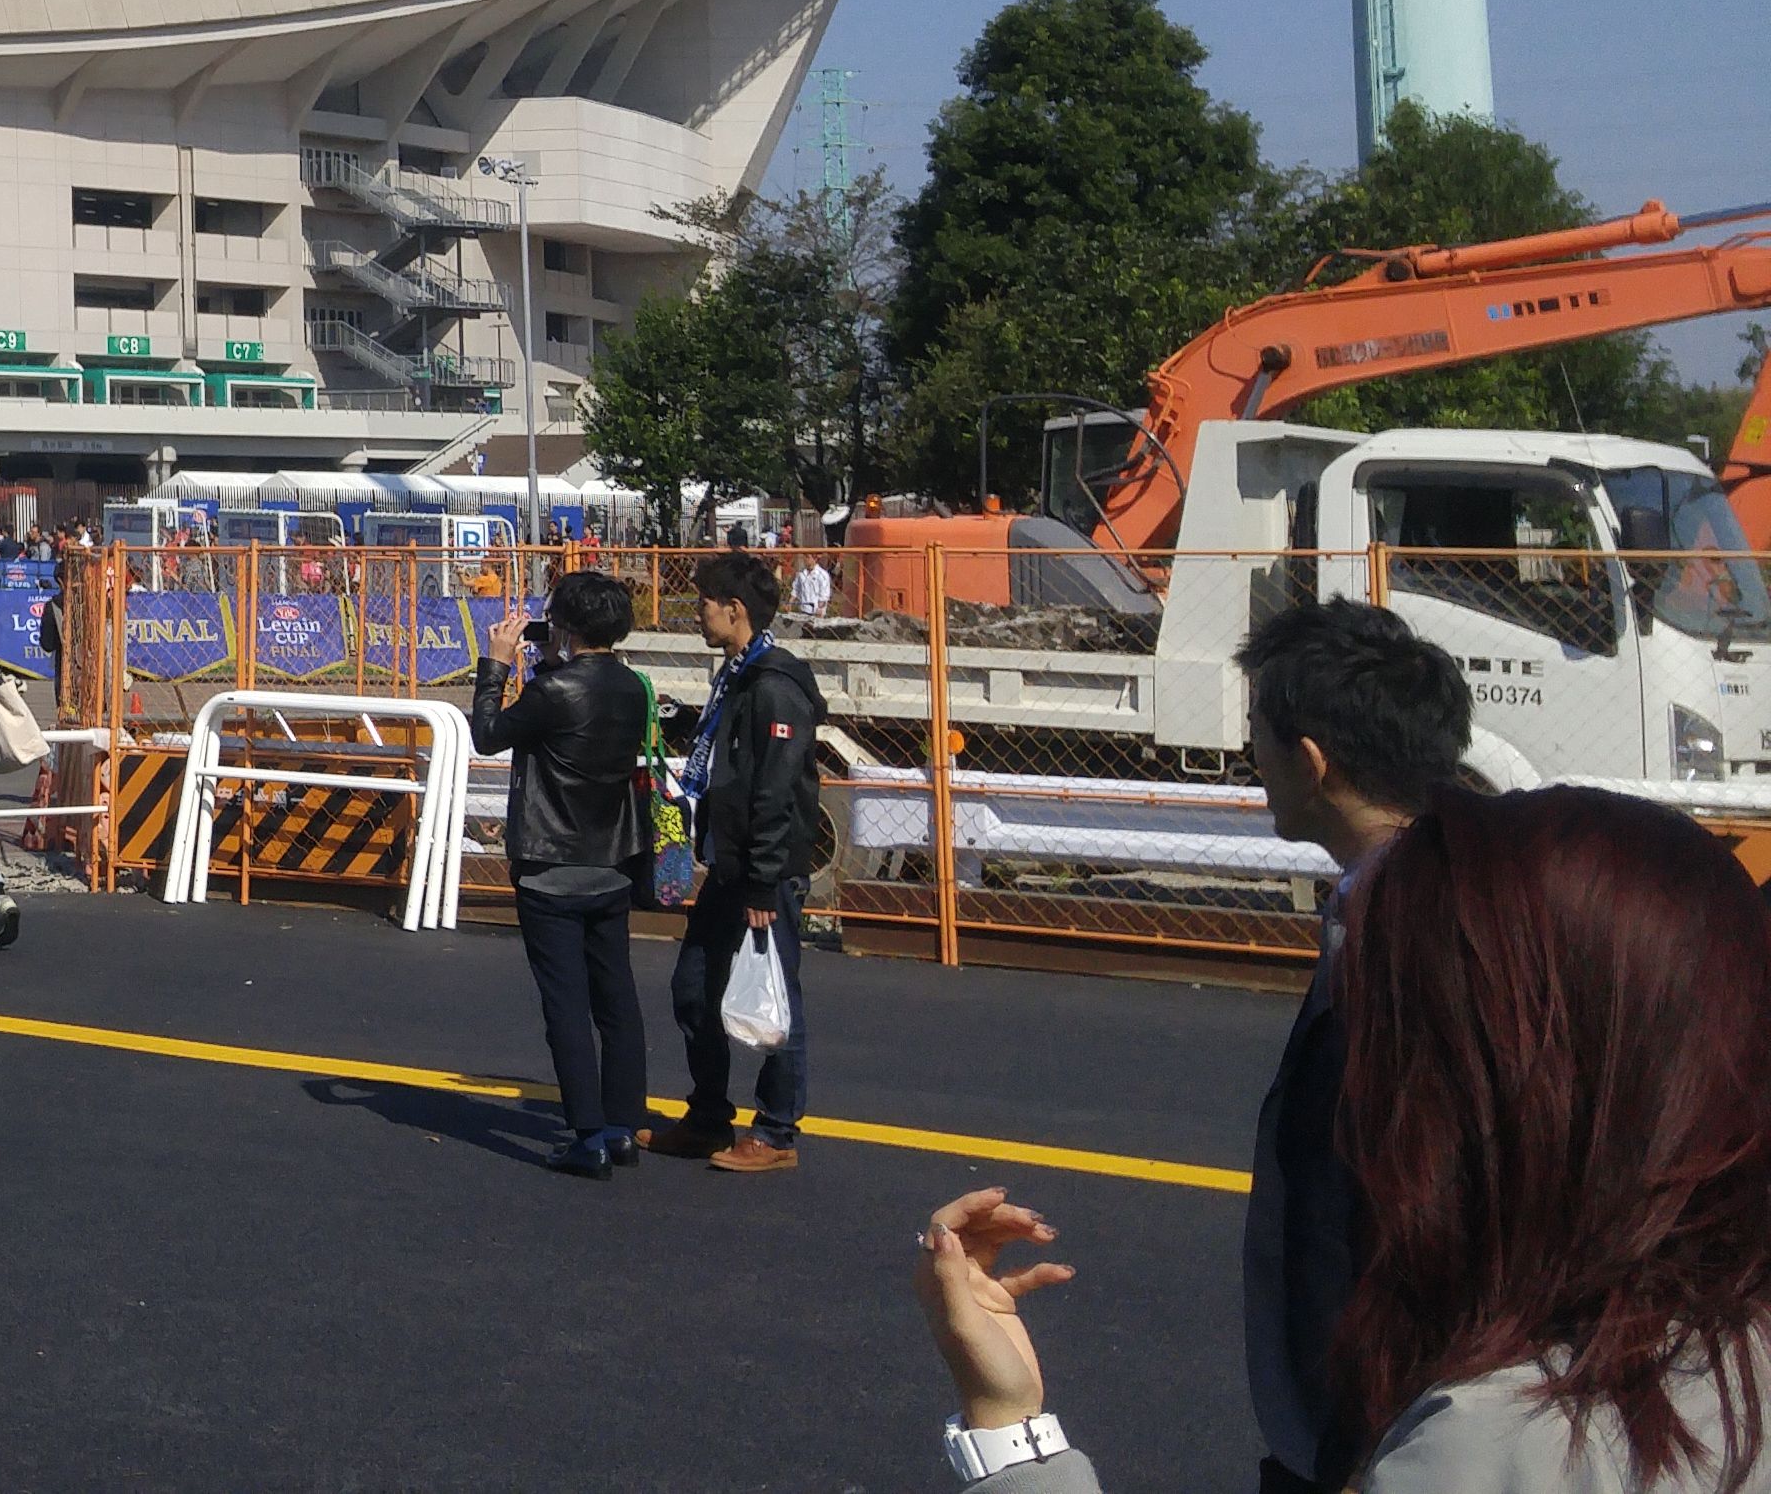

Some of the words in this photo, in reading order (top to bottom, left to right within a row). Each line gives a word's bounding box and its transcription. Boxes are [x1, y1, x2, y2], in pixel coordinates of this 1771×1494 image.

[119, 337, 139, 354] C8
[233, 343, 250, 359] C7
[463, 530, 481, 557] B
[124, 618, 219, 644] FINAL
[258, 617, 321, 633] Levain
[275, 632, 308, 645] CUP
[270, 646, 320, 658] FINAL
